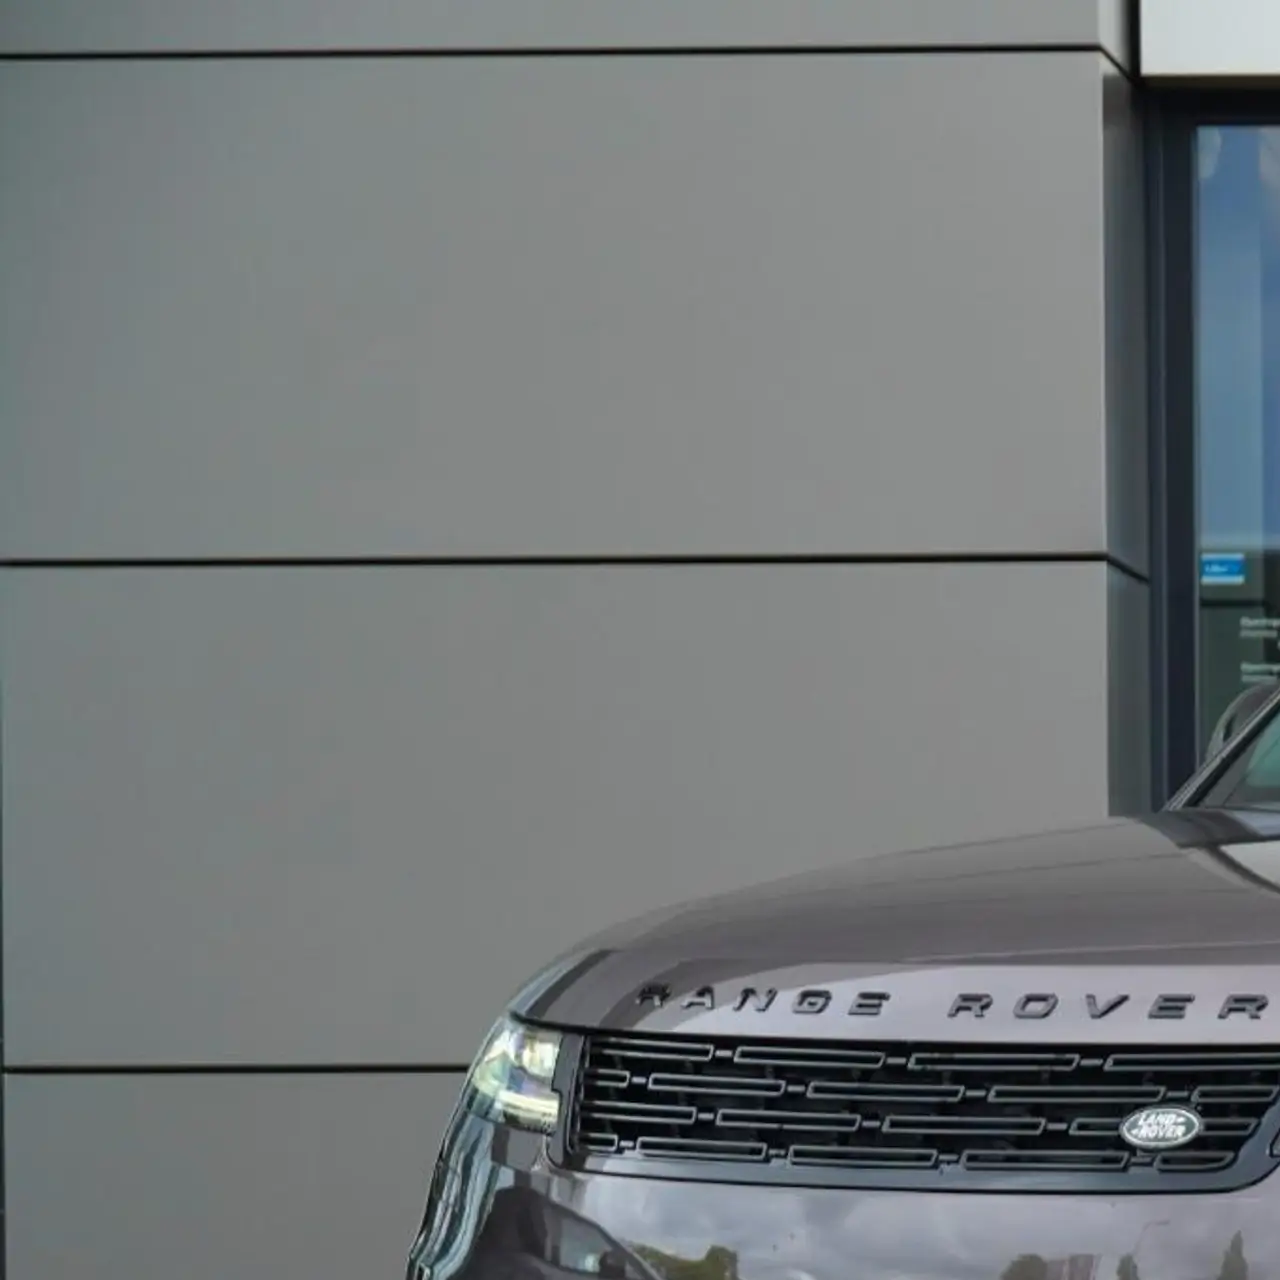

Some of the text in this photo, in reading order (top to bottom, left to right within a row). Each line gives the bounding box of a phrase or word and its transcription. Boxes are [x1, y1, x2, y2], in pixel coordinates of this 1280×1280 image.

[635, 984, 1269, 1019] RANGE ROVER
[1138, 1112, 1177, 1126] LAND
[1138, 1124, 1187, 1139] ROVER
